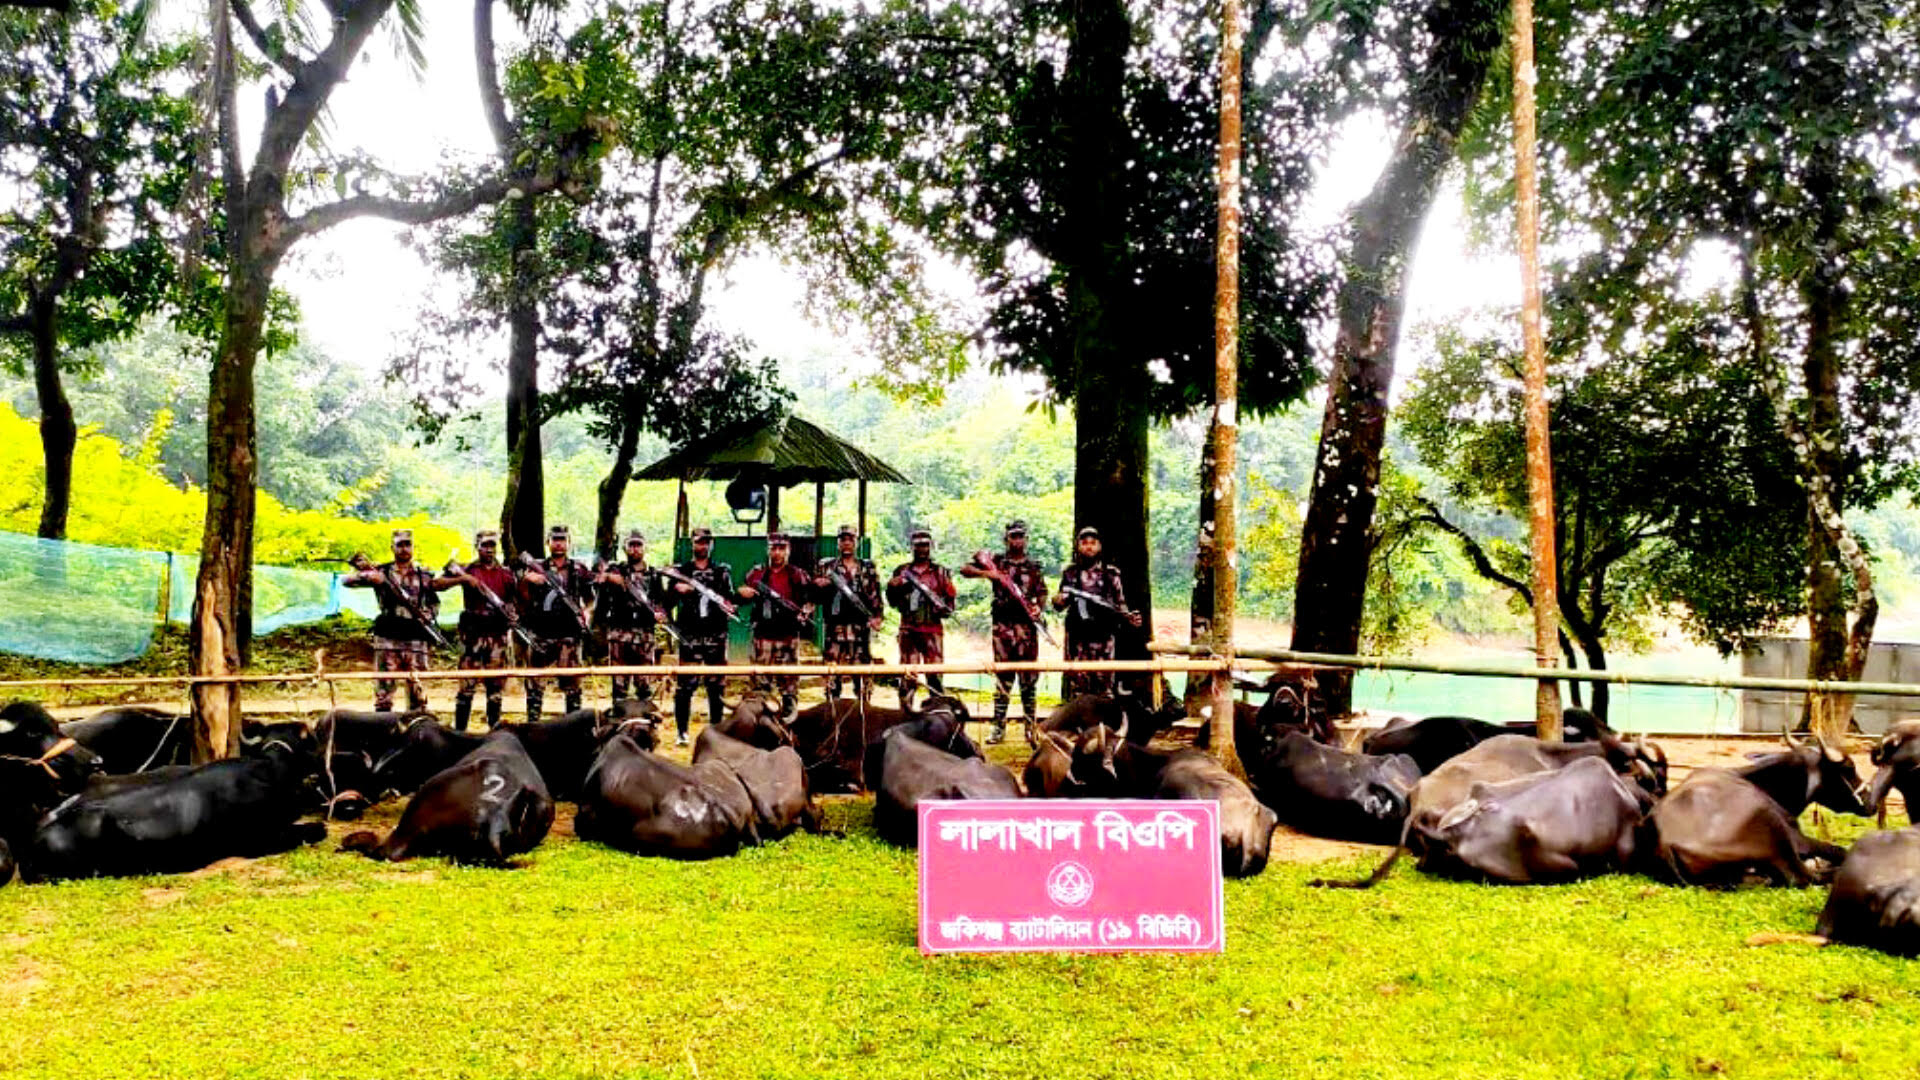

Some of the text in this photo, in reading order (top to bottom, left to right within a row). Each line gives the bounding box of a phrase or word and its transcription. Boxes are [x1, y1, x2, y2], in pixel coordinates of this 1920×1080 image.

[480, 774, 505, 803] 2
[938, 810, 1198, 851] লালাখাল বিওপি
[939, 914, 1004, 942] জকিগঞ্জ
[1098, 917, 1132, 945] (১৯
[1136, 913, 1201, 945] বিজিবি)
